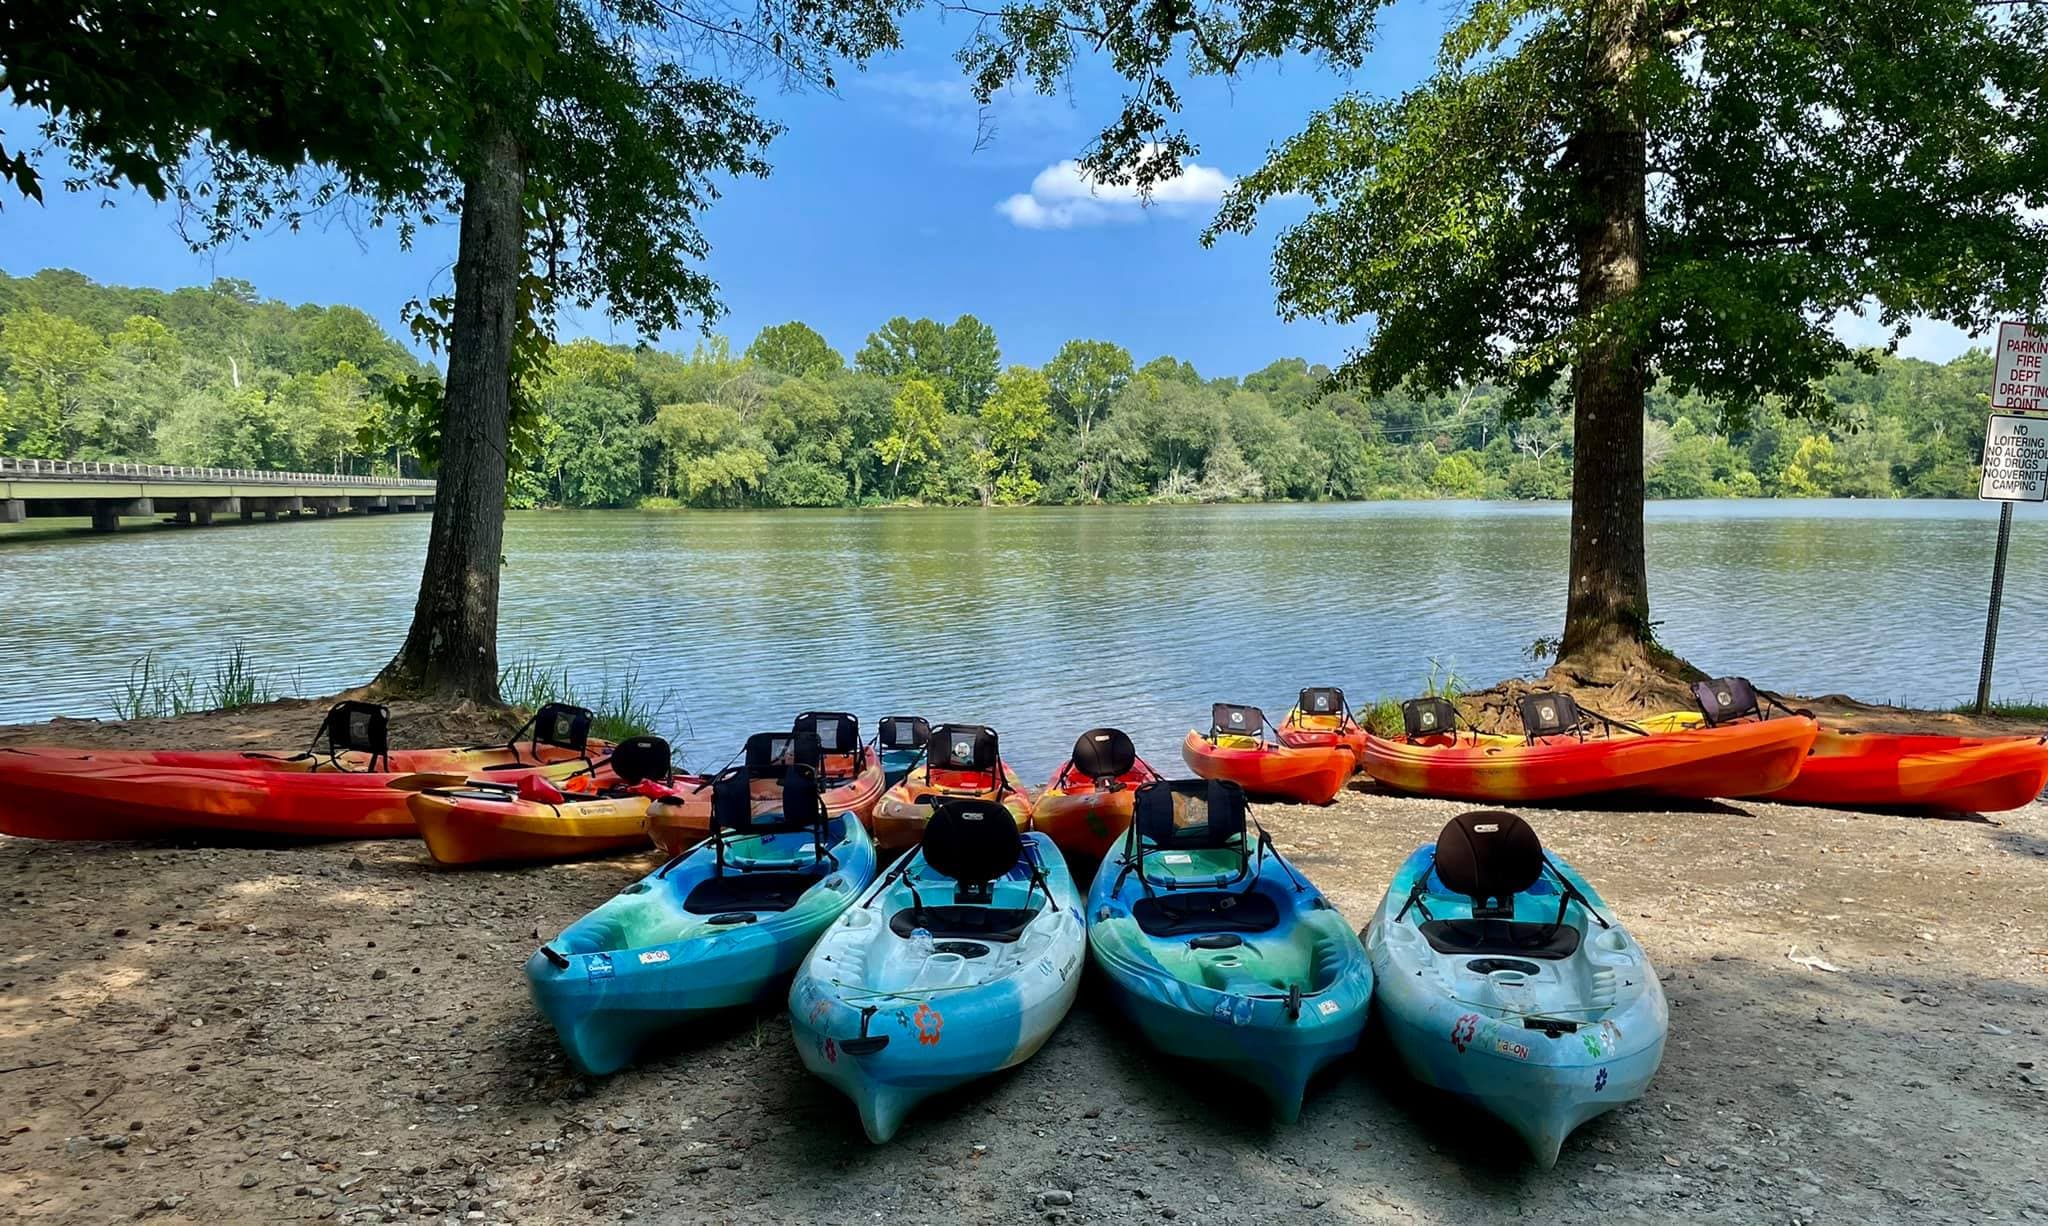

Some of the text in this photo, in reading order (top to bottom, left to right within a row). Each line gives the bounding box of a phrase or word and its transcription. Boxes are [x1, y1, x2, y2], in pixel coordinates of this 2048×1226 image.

[2024, 325, 2040, 338] NO
[2016, 354, 2042, 368] FIRE
[2010, 369, 2040, 382] DEPT
[2006, 397, 2040, 409] POINT
[2013, 425, 2028, 435] NO
[1994, 435, 2045, 448] LOITERING
[1987, 446, 2048, 459] NO ALCOHOL
[1985, 457, 2038, 469] NO DRUGS
[2000, 469, 2047, 481] OVERNITE
[1992, 480, 2036, 491] CAMPING
